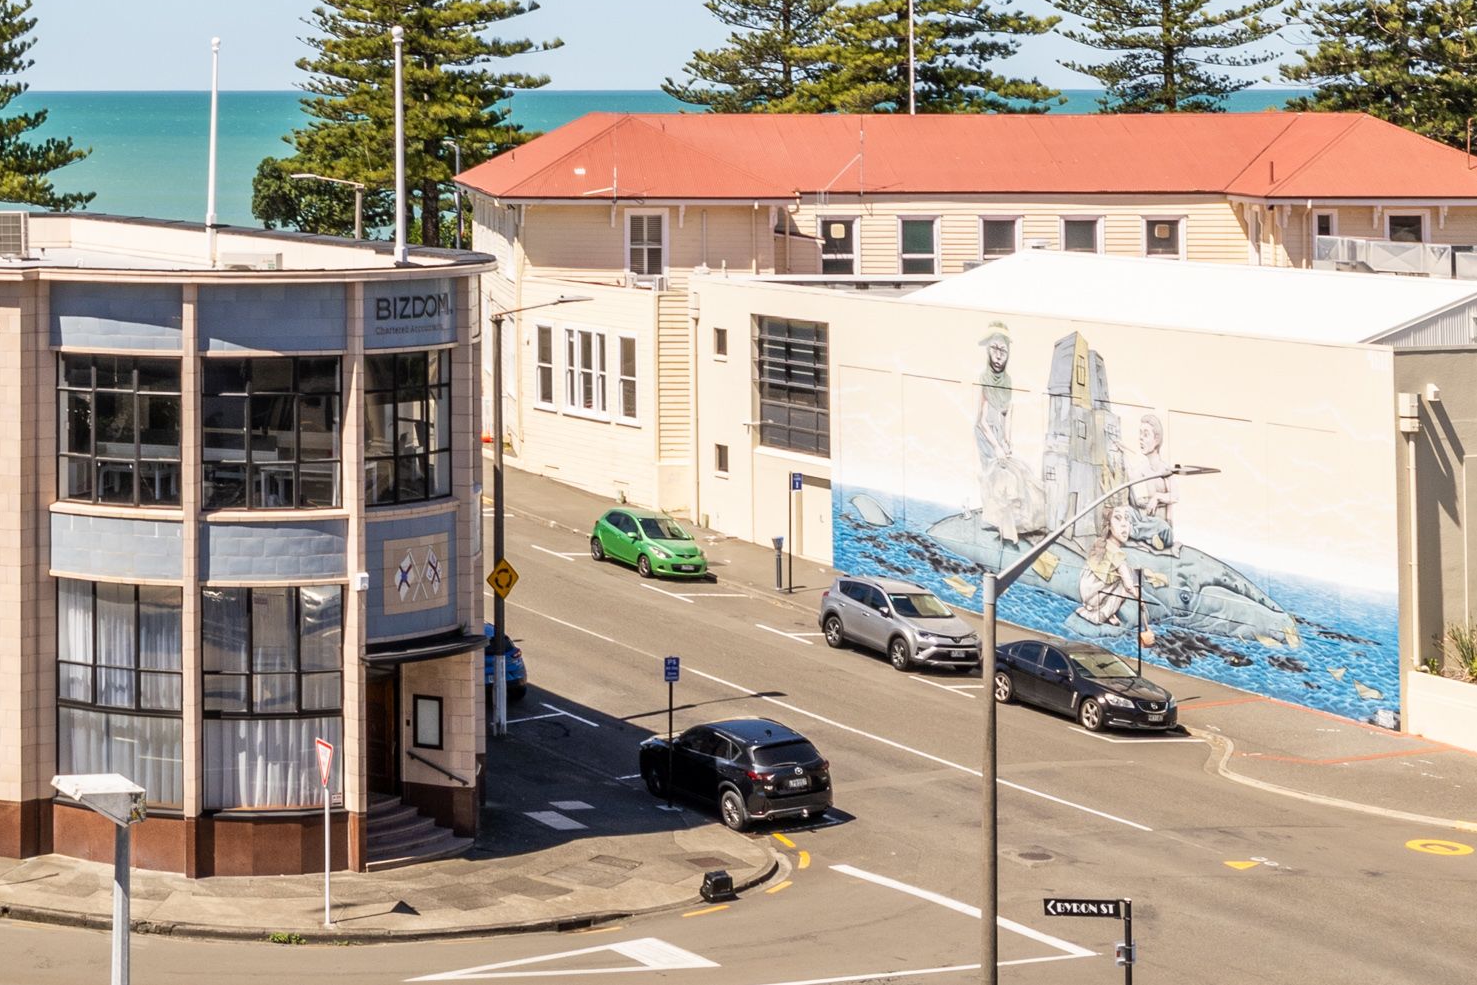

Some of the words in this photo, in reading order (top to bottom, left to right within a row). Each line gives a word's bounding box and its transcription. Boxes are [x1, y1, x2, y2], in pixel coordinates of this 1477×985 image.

[375, 325, 409, 335] Chartered
[1056, 902, 1098, 914] BYRON
[1099, 903, 1116, 914] ST
